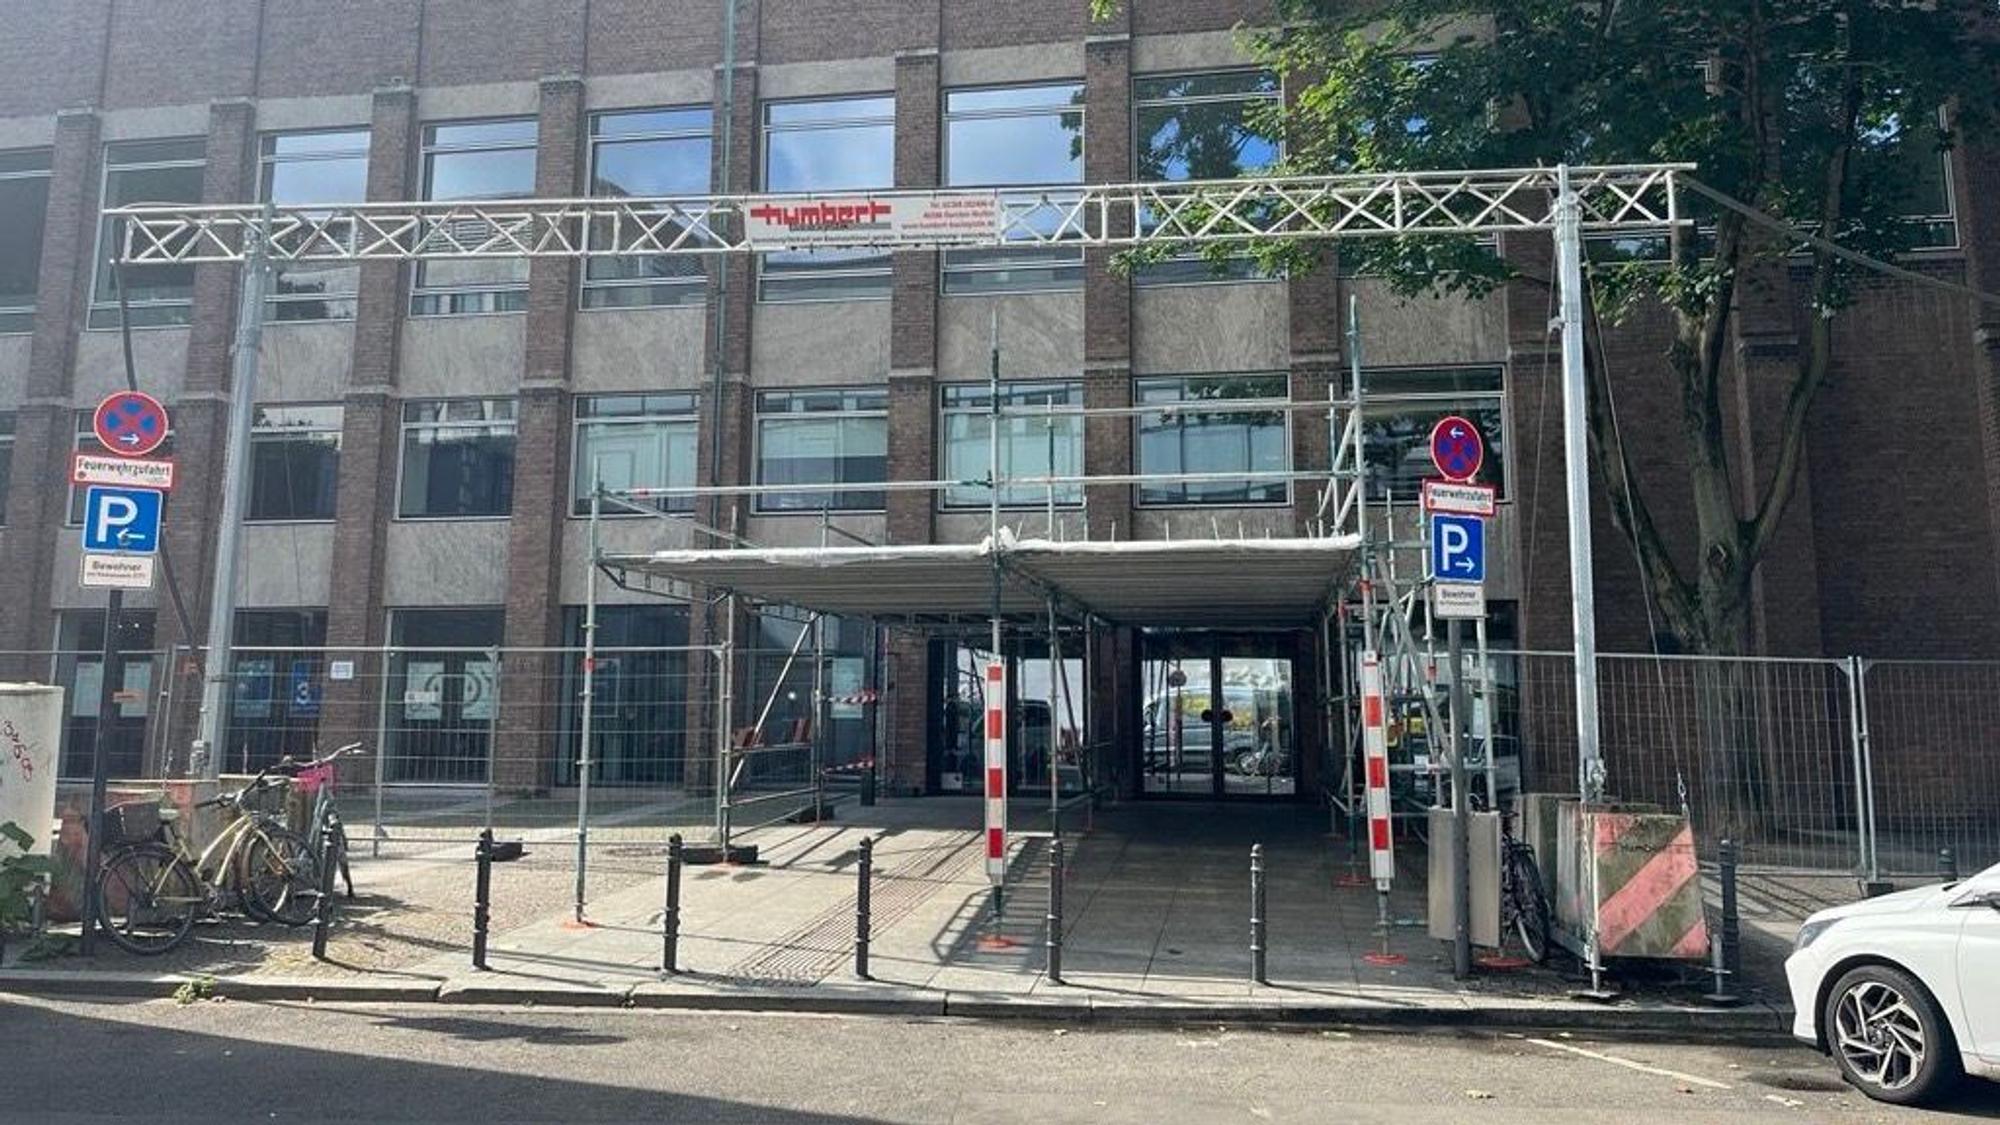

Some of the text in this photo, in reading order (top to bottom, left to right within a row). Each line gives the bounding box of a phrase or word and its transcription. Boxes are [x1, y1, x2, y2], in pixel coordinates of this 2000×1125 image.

[751, 201, 891, 226] humbert
[78, 456, 171, 476] Feuerwehrzufahrt
[97, 495, 139, 543] P
[1441, 523, 1468, 572] P
